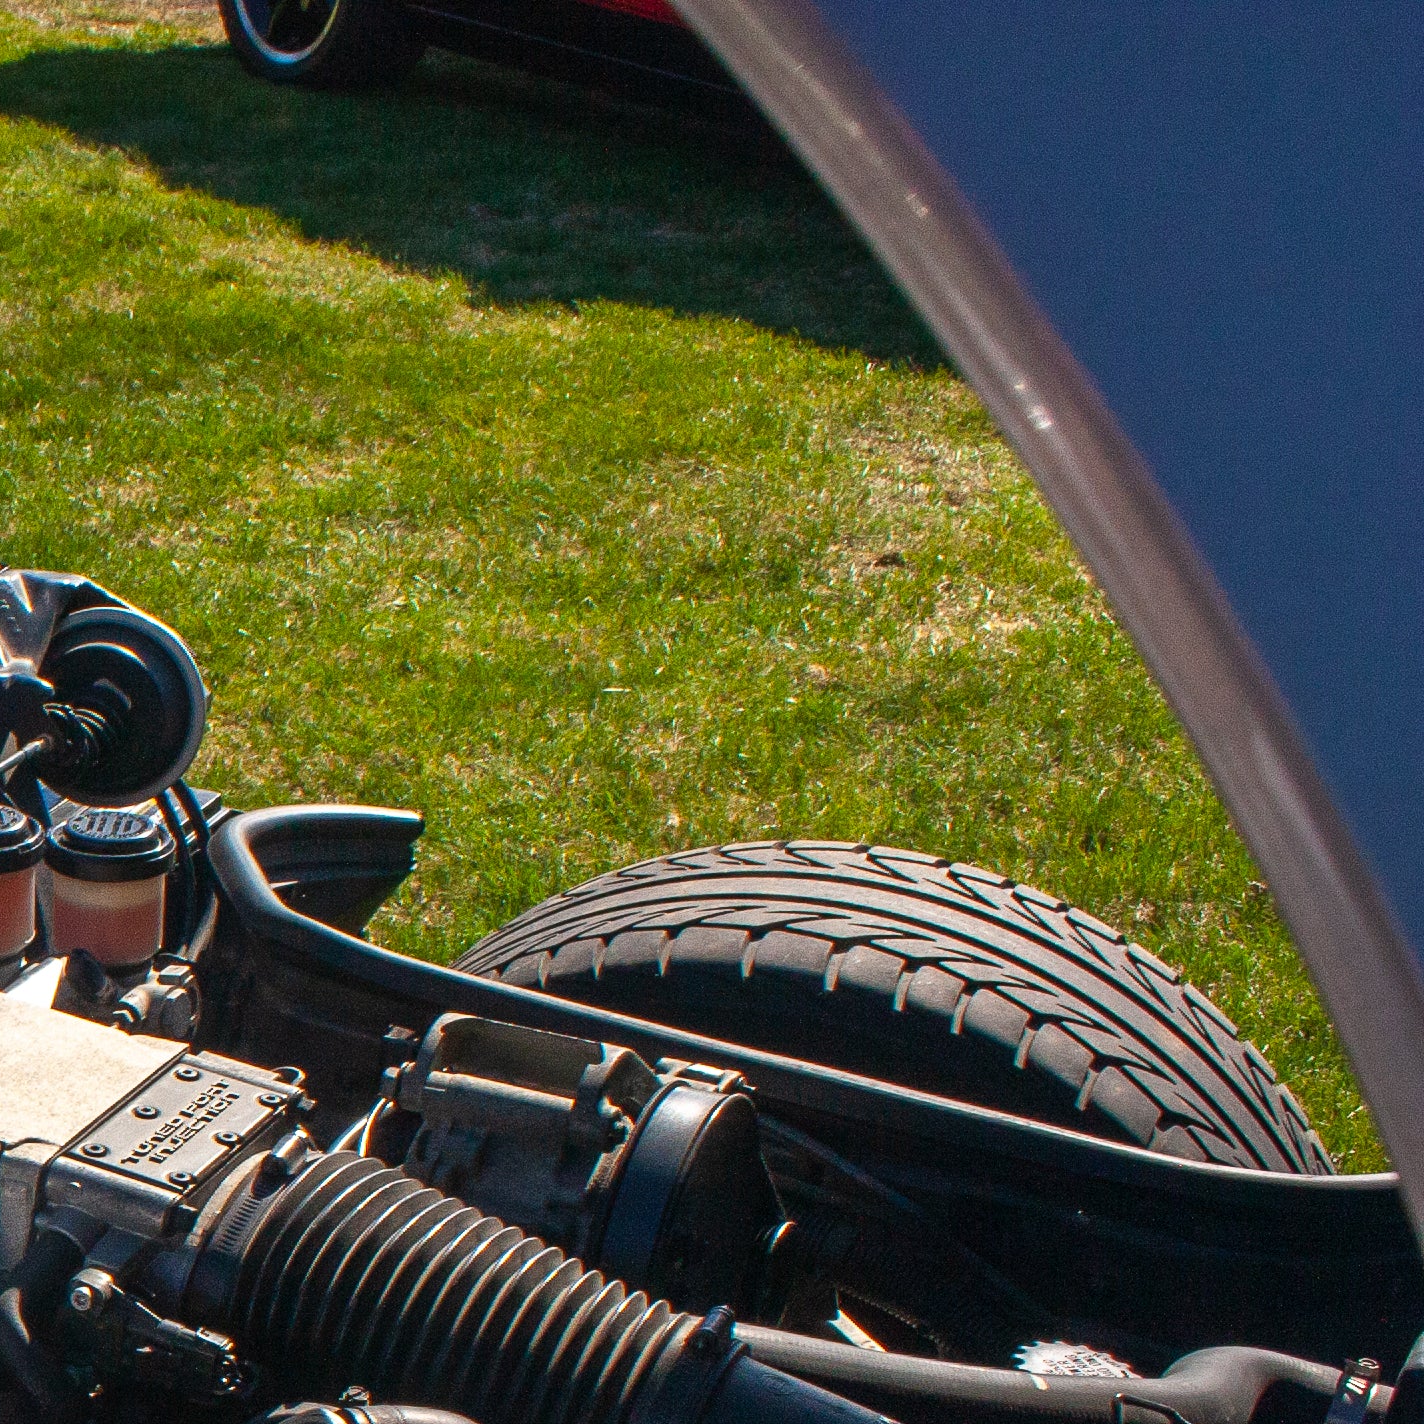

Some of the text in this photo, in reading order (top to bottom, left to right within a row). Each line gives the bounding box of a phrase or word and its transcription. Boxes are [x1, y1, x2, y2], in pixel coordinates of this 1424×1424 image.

[121, 1080, 230, 1164] TUNED PORT
[148, 1092, 240, 1163] INJECTION
